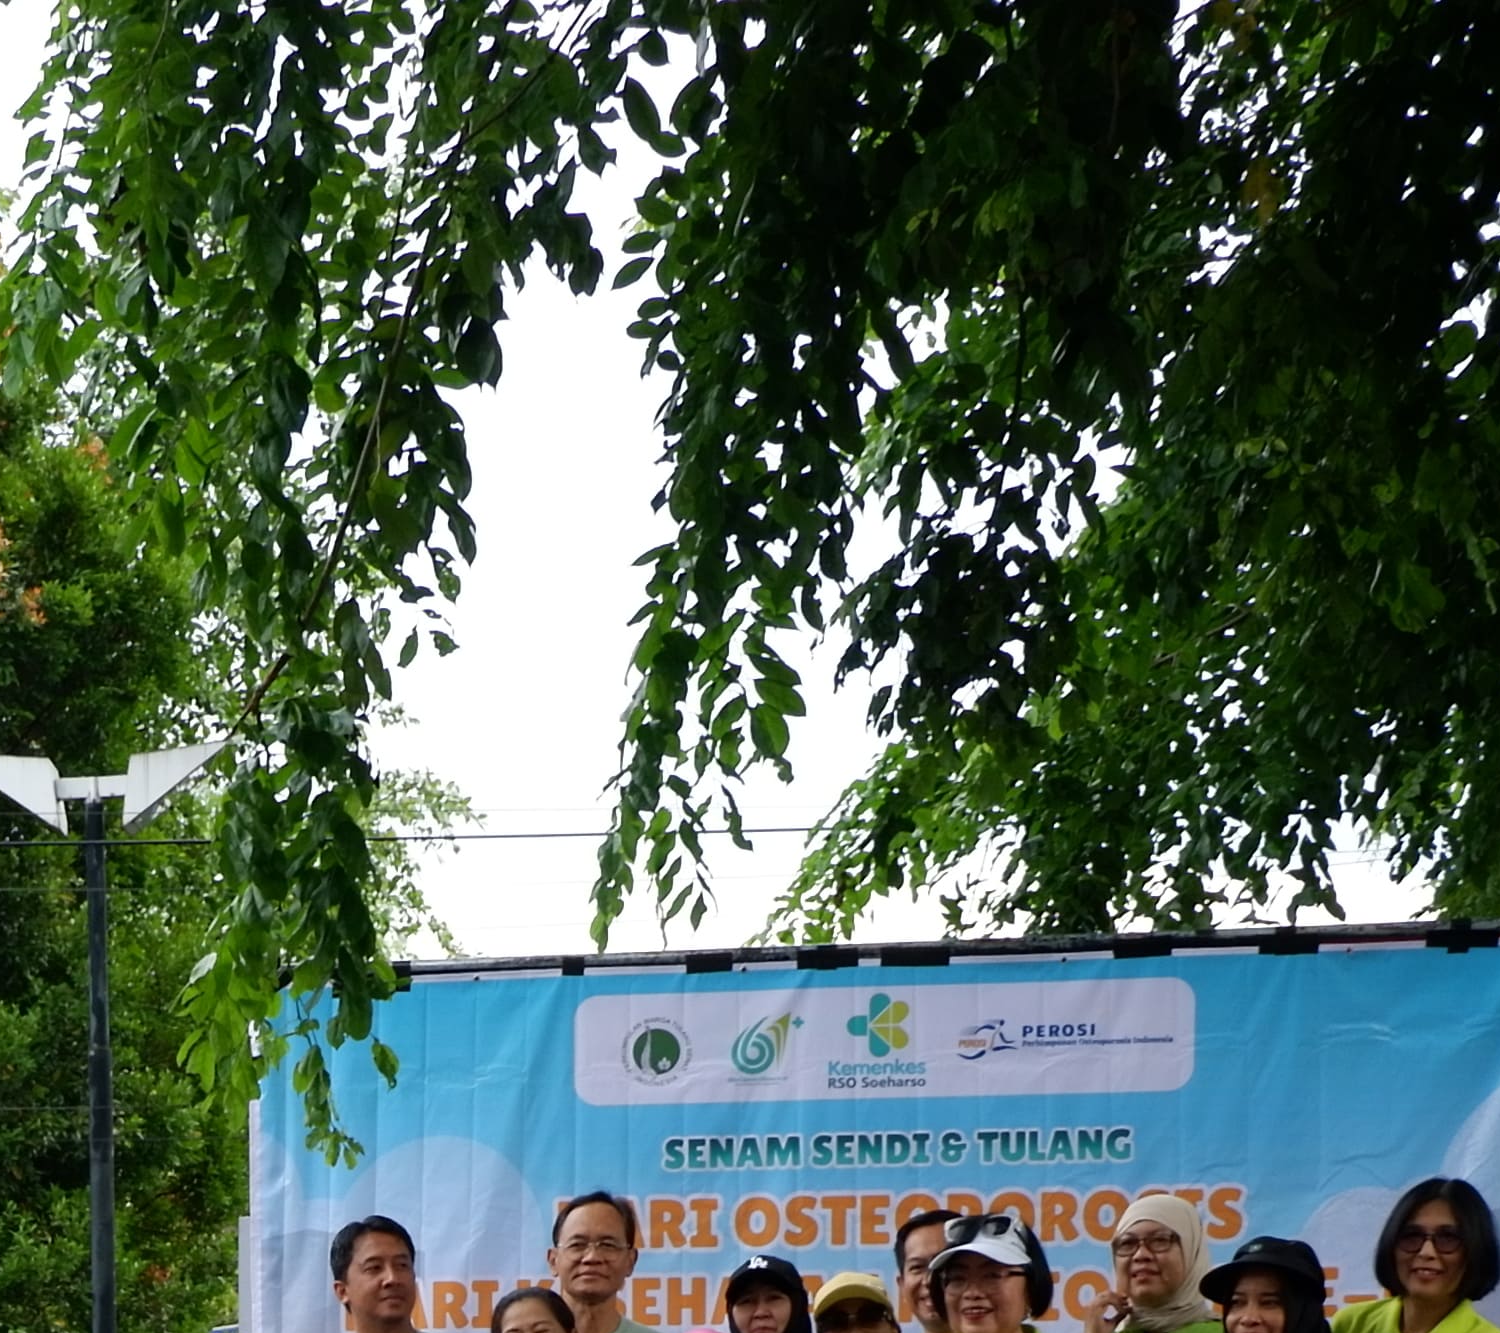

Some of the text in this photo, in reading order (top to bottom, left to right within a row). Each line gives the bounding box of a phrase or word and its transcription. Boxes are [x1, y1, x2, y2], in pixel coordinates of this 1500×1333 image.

[1022, 1023, 1096, 1038] PEROSI
[828, 1059, 927, 1078] Kemenkes
[828, 1074, 927, 1090] RSO Soeharso
[665, 1128, 1132, 1169] SENAM SENDI & TULANG
